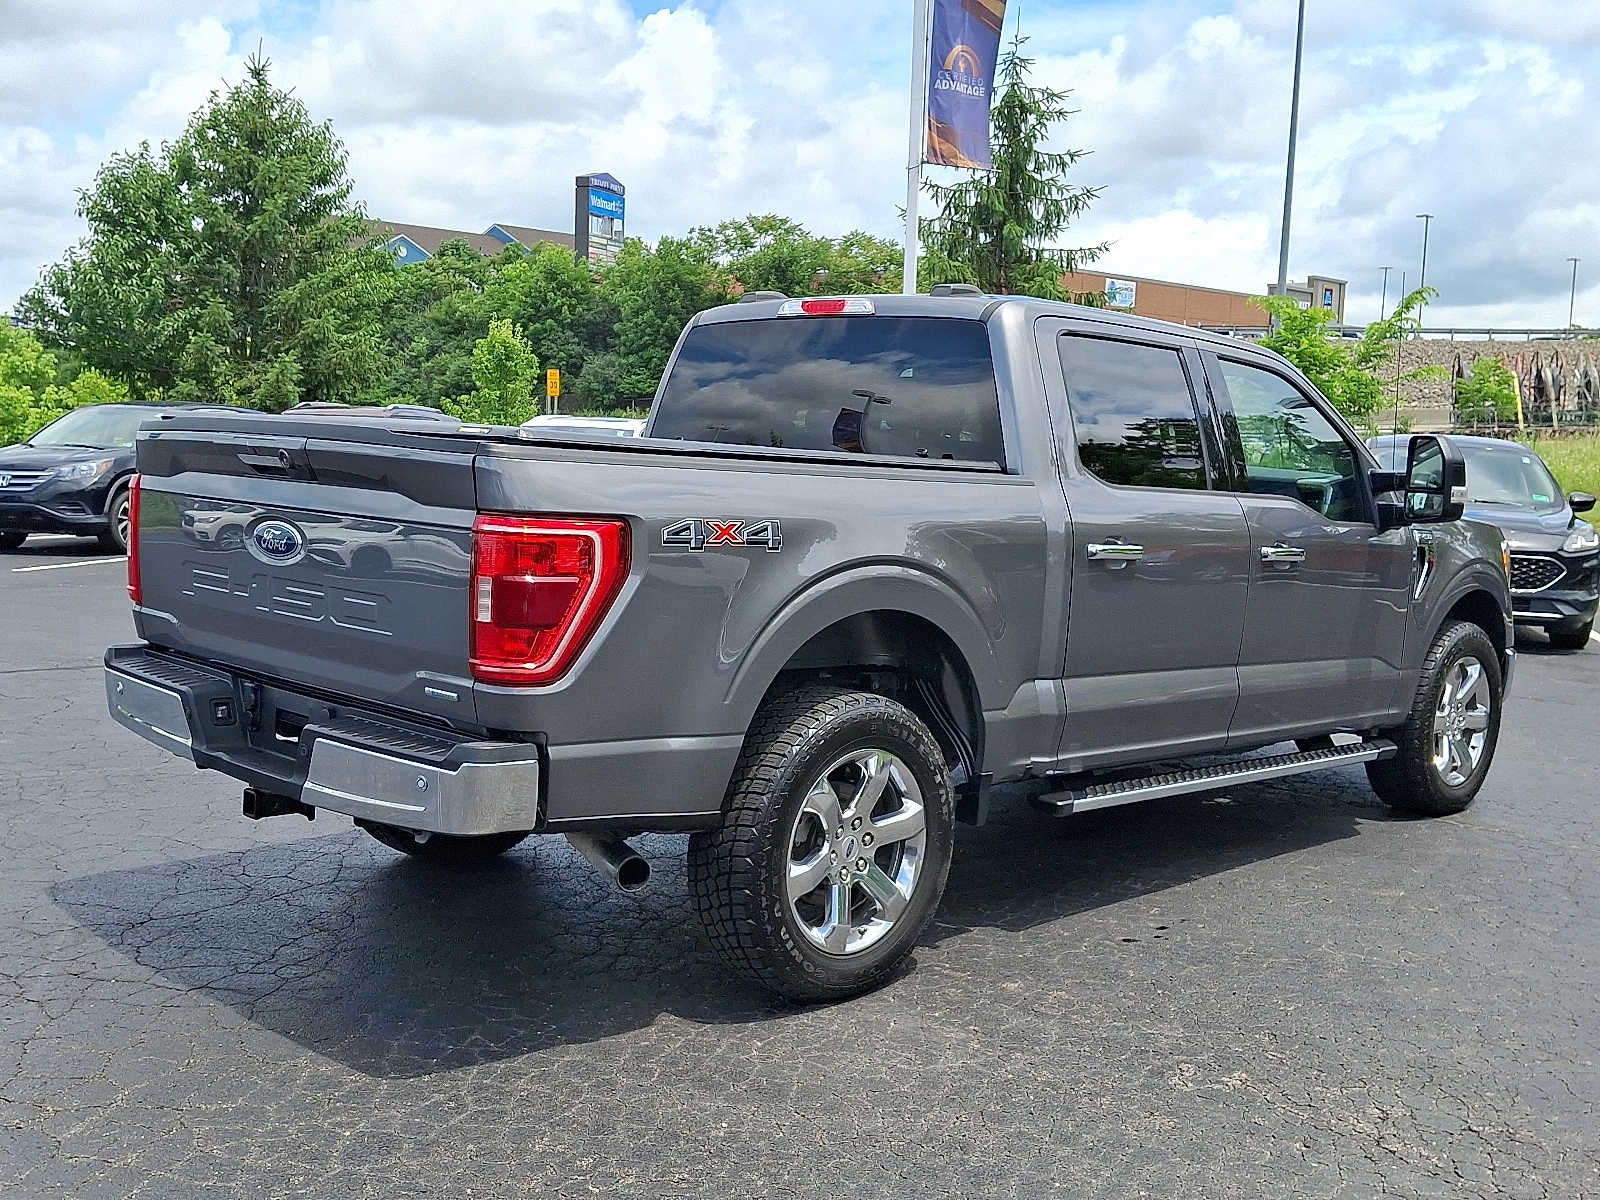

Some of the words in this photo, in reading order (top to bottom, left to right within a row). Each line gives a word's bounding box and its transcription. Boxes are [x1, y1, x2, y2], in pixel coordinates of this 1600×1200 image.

[937, 70, 984, 87] CERTIFIED
[590, 193, 617, 212] Walmart
[260, 528, 290, 552] Ford
